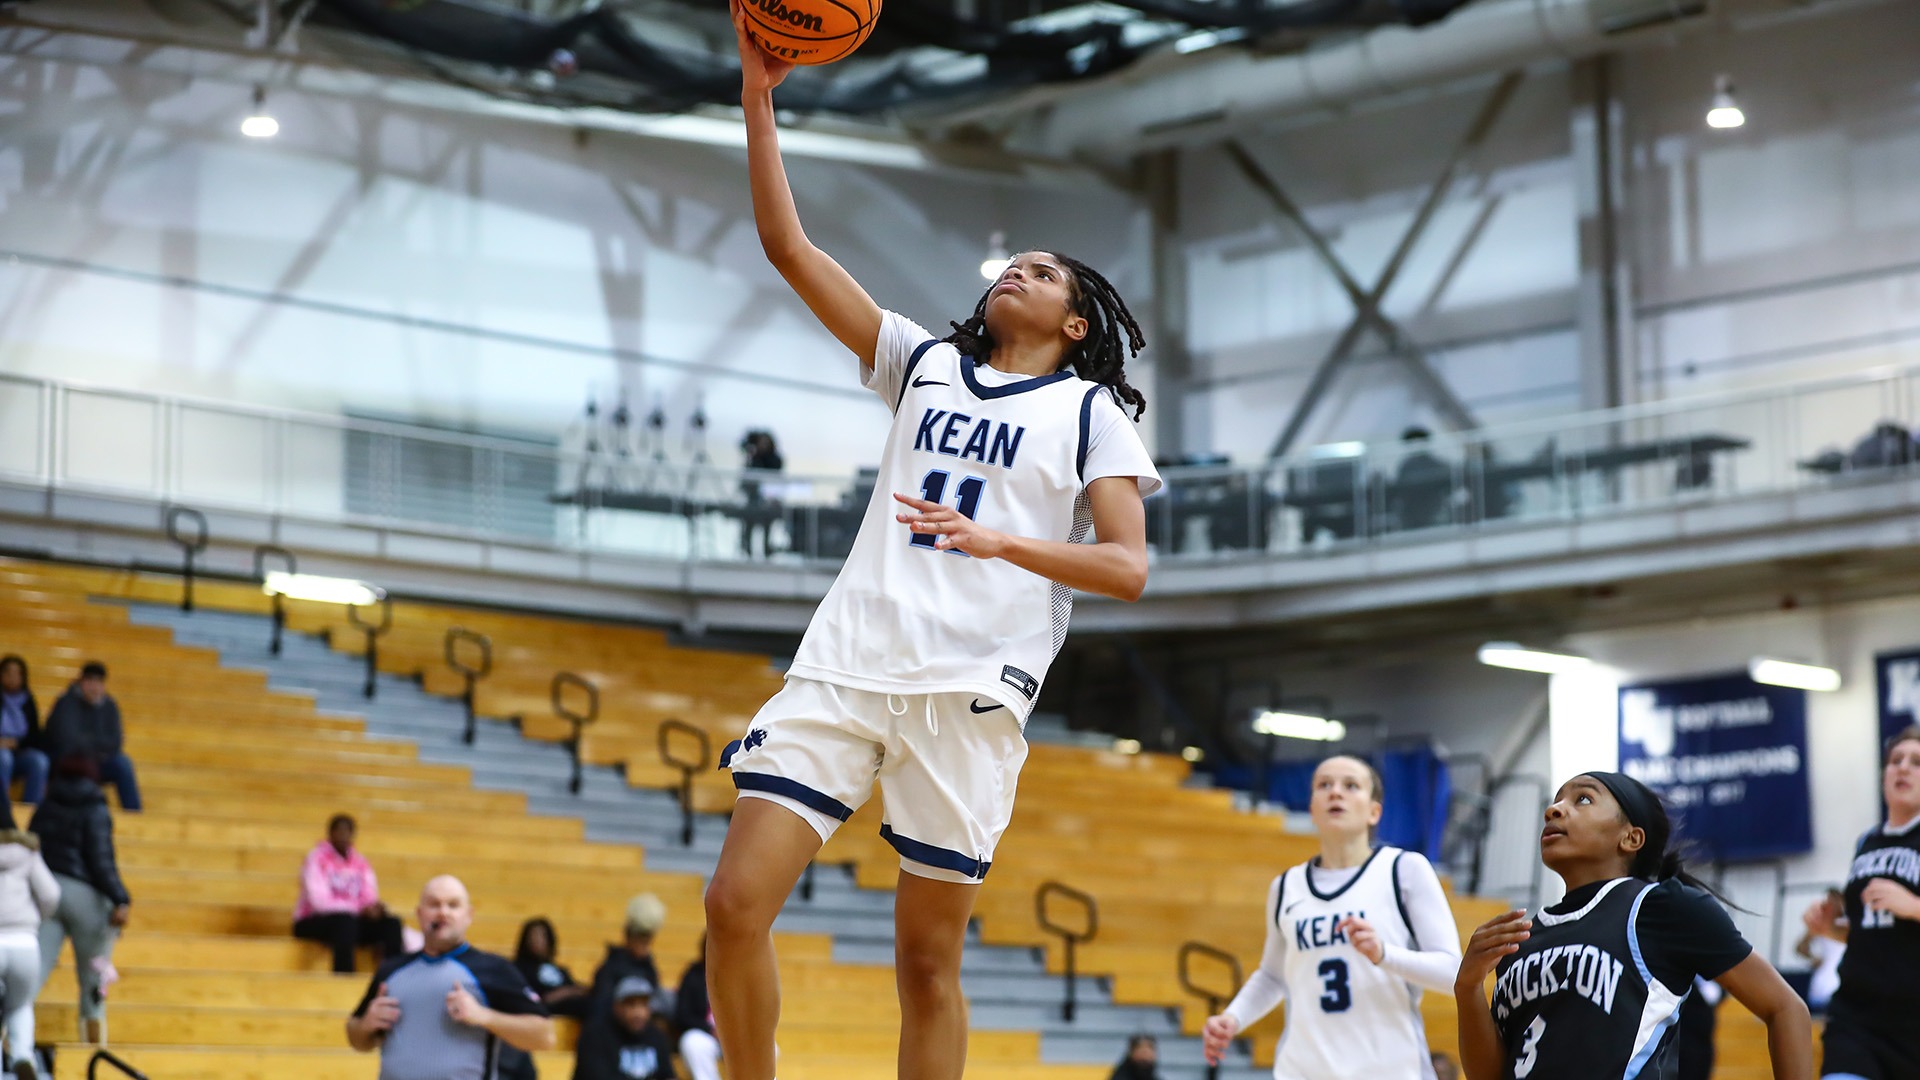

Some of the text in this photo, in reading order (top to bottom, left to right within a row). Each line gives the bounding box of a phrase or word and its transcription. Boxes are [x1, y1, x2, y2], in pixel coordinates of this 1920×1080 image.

[749, 0, 823, 32] ilson
[913, 407, 1026, 470] KEAN
[909, 468, 987, 558] 11
[1296, 911, 1365, 951] KEA
[1318, 957, 1352, 1014] 3
[1493, 944, 1624, 1019] TOCKTON
[1514, 1013, 1547, 1080] 3
